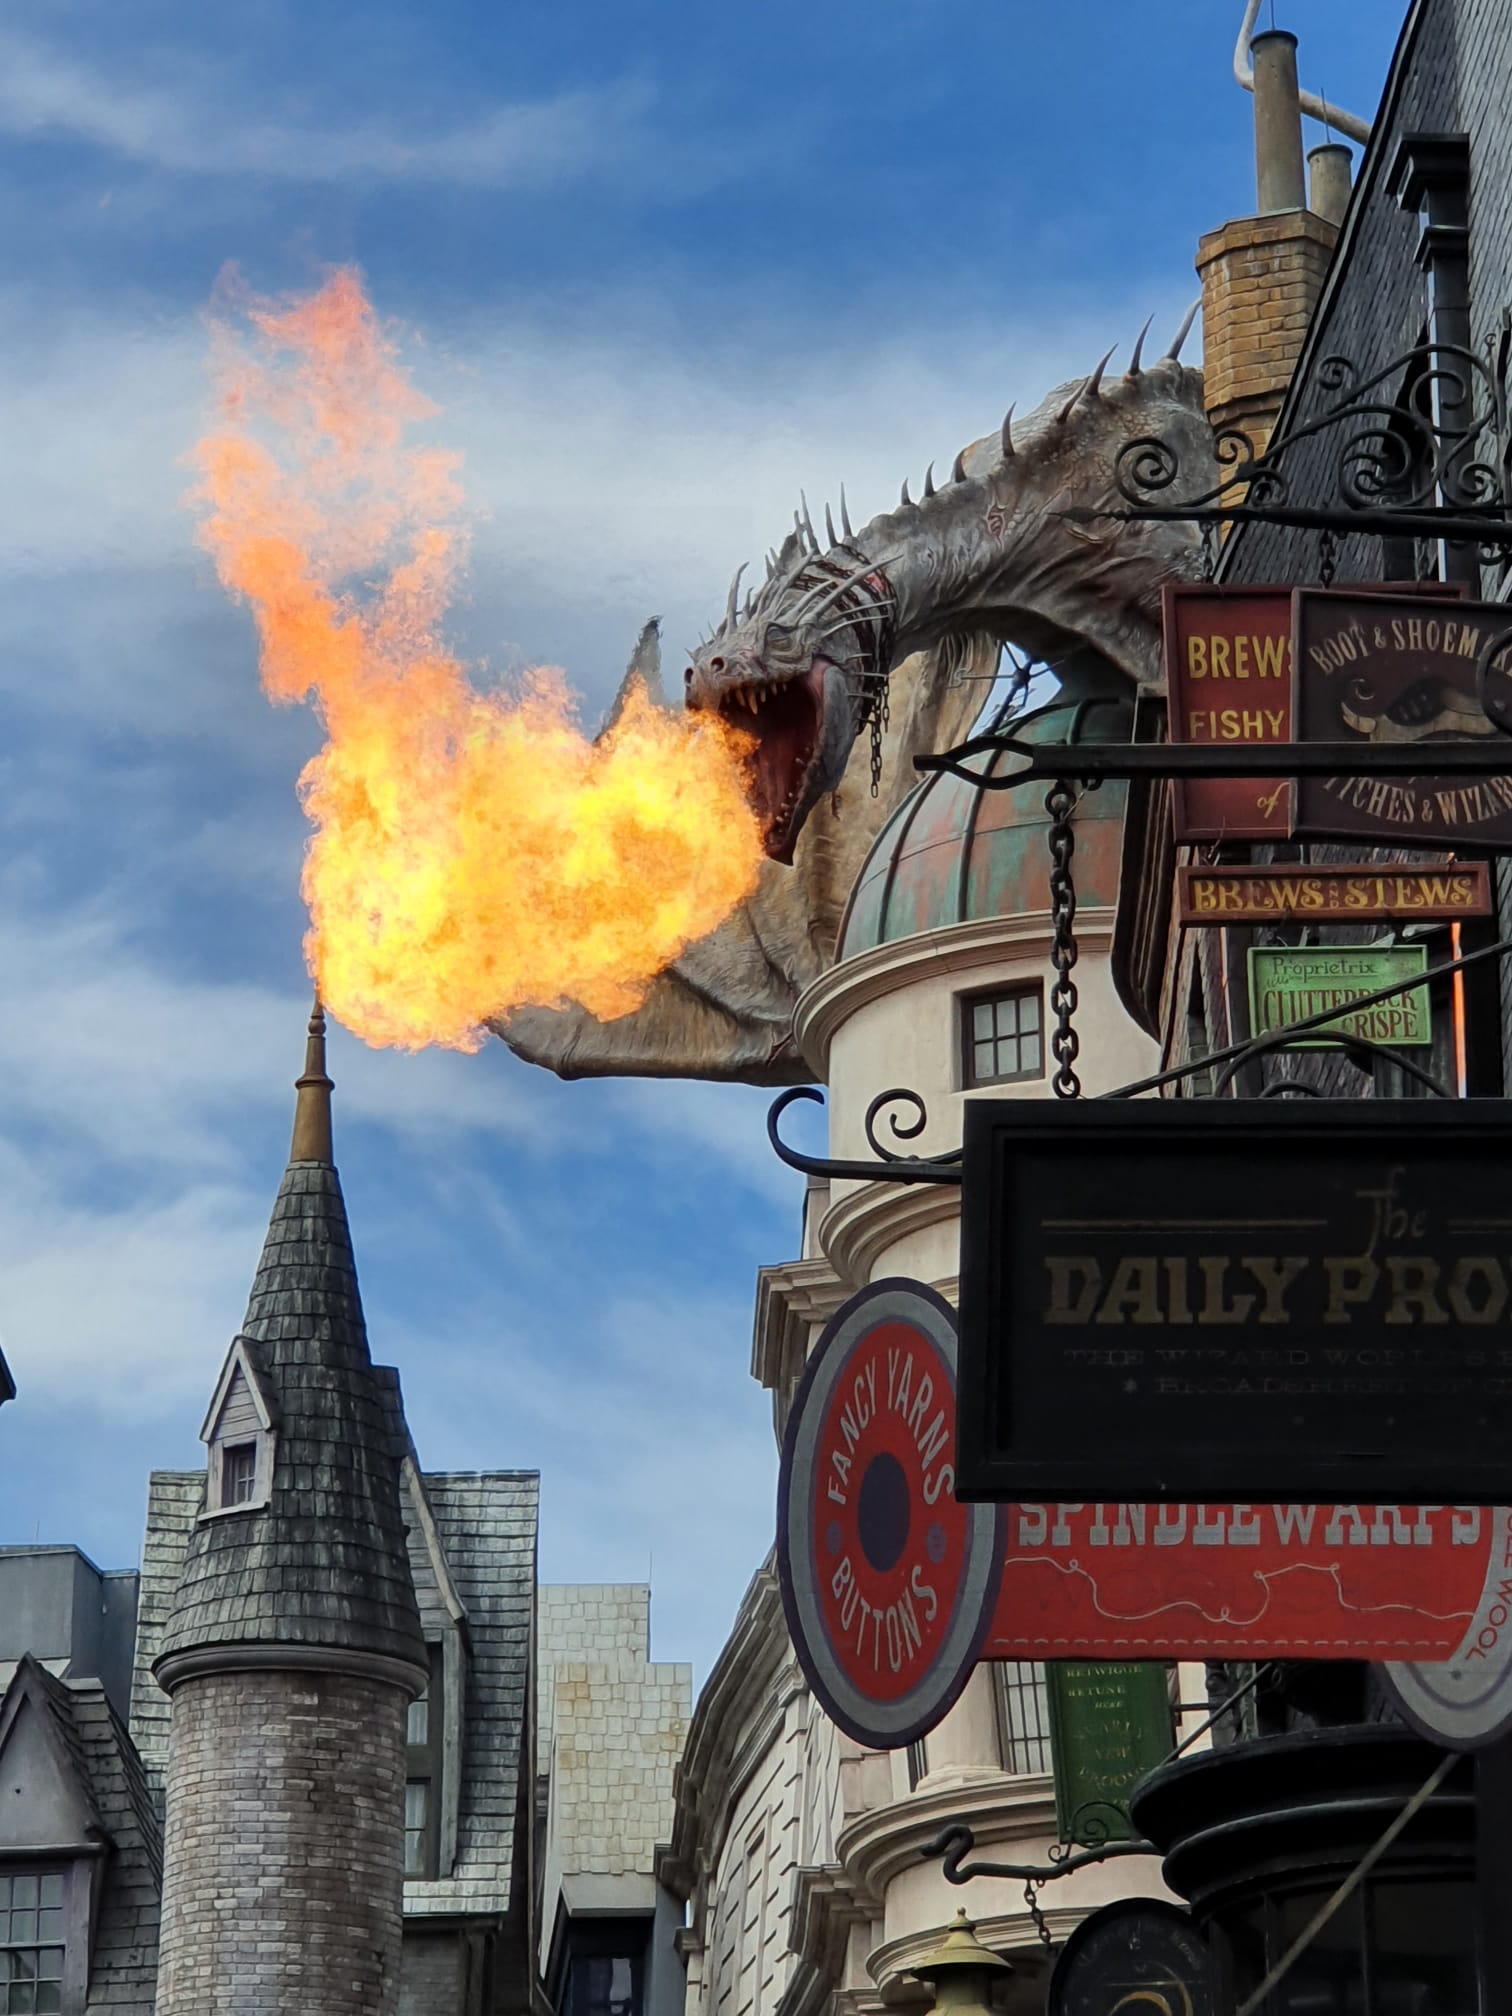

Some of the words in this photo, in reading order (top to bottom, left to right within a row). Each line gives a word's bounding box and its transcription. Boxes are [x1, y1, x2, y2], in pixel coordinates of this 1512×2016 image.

[1188, 635, 1292, 679] BREW
[1309, 623, 1370, 675] BOOT
[1373, 626, 1387, 648] &
[1189, 709, 1285, 740] FISHY
[1257, 782, 1290, 819] of
[1420, 799, 1433, 823] &
[1193, 878, 1325, 912] BREWS
[1344, 875, 1473, 909] STEWS
[1272, 956, 1377, 984] Proprietrix
[1342, 1010, 1418, 1039] CRISPE
[1041, 1255, 1309, 1325] DAILY
[1322, 1255, 1512, 1326] PRO
[1063, 1348, 1145, 1367] THE
[827, 1356, 876, 1506] FANCY
[888, 1348, 955, 1506] YARNS
[832, 1556, 937, 1673] BUTTONS
